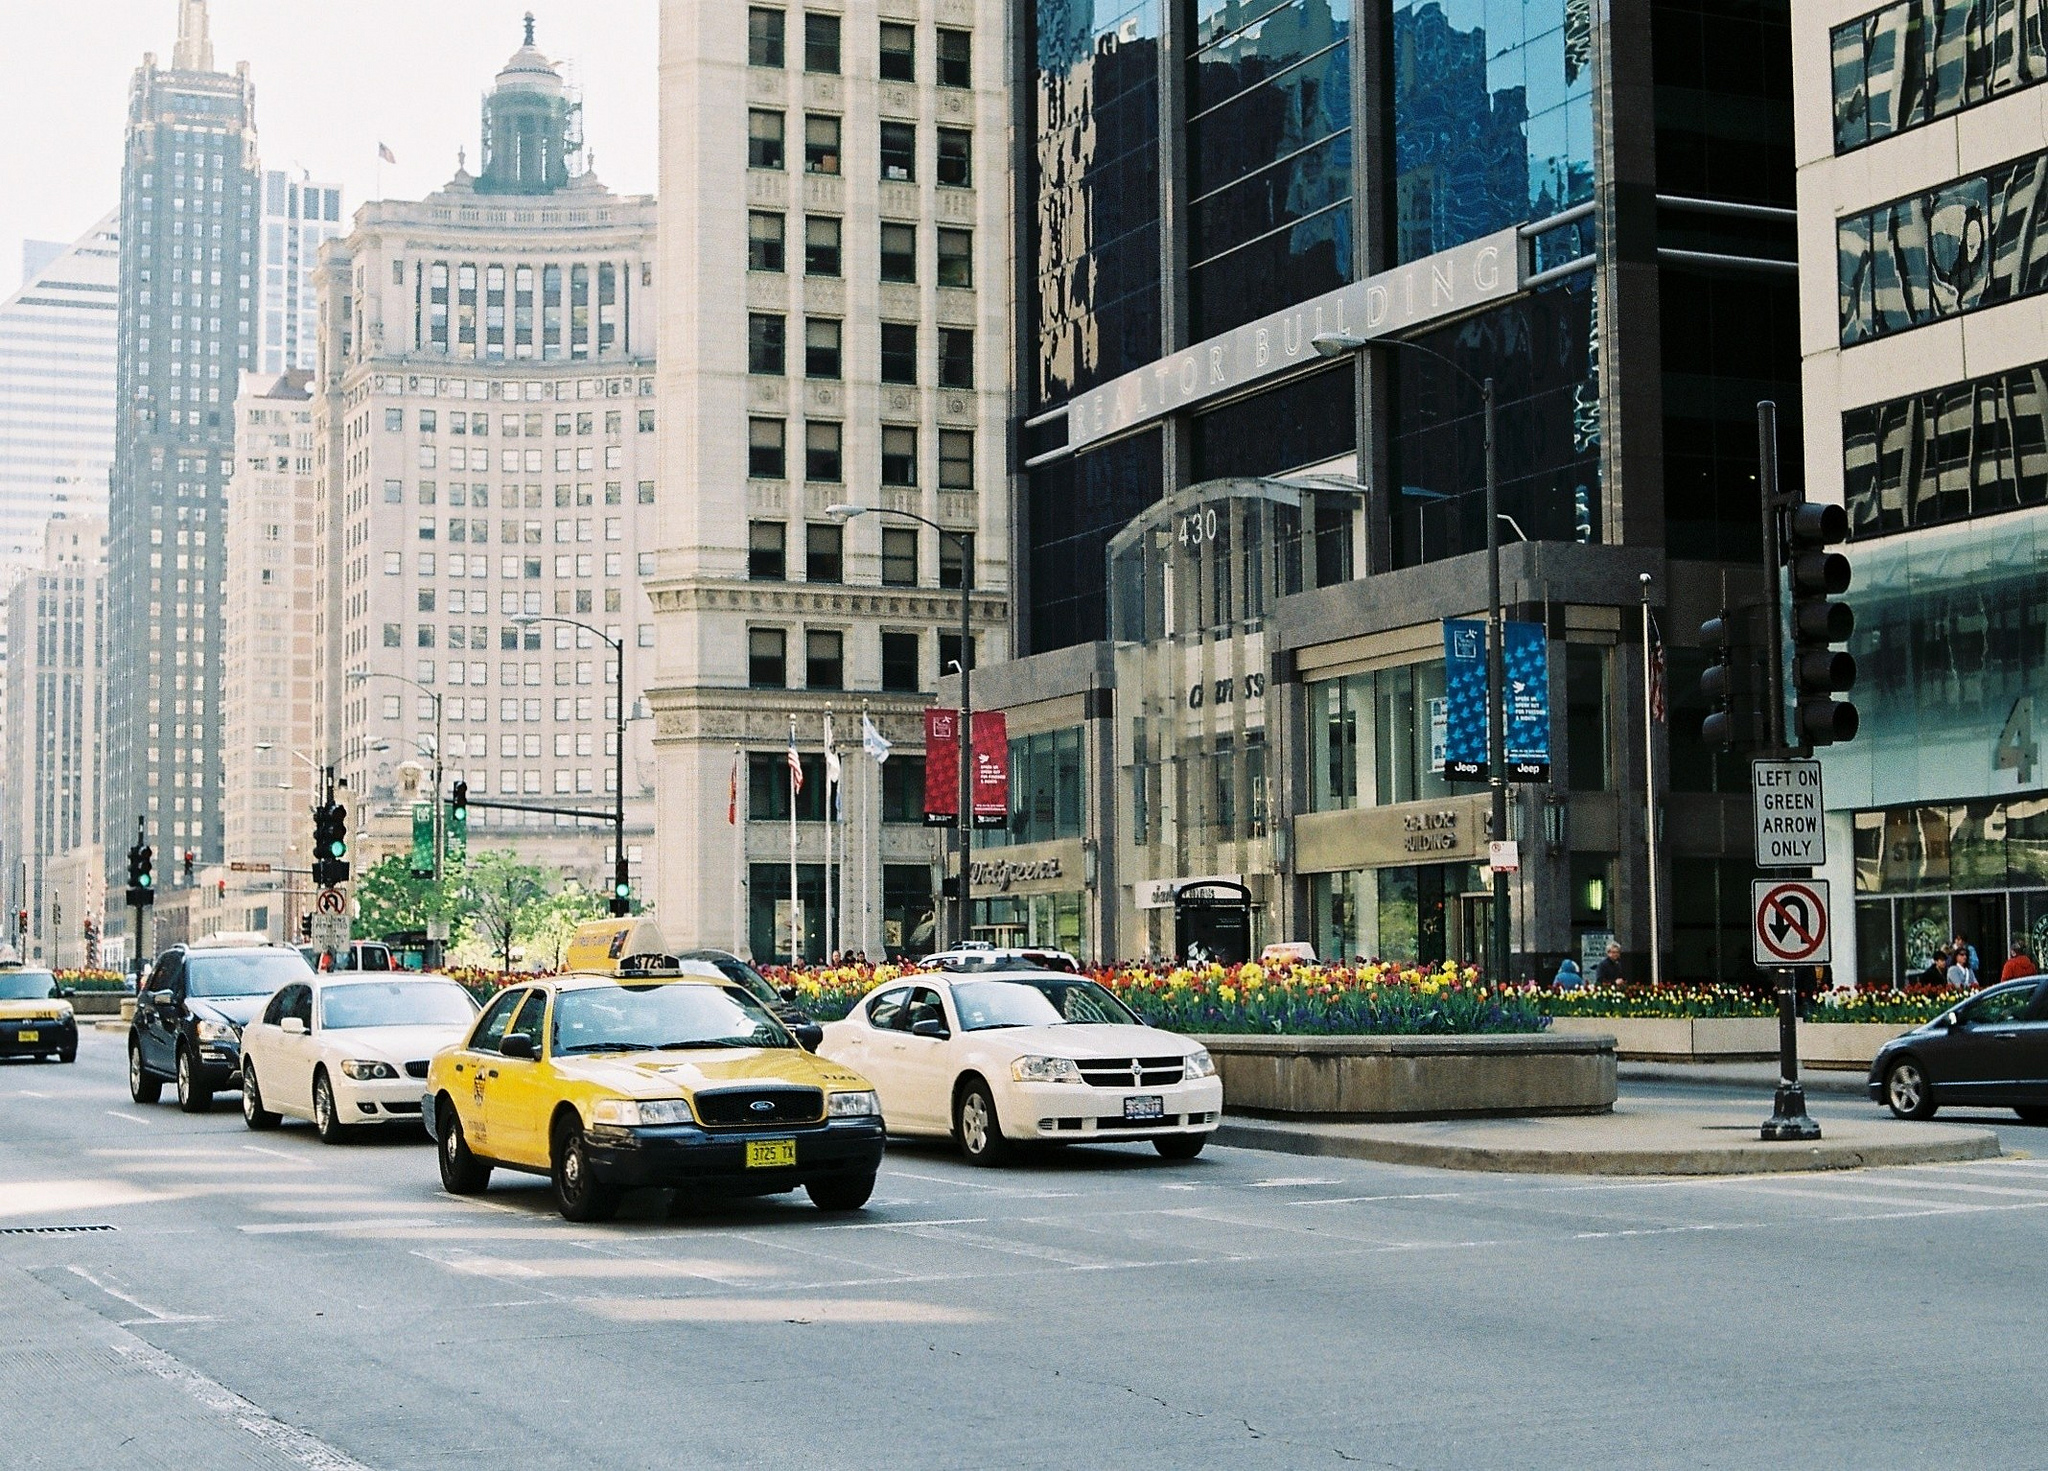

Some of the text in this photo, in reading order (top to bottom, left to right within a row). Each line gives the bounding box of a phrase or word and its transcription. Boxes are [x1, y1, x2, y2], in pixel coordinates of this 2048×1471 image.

[1255, 245, 1499, 368] BUILDING
[1178, 508, 1217, 547] 430
[1454, 762, 1478, 774] Jeep
[1517, 763, 1540, 775] Jeep
[1757, 770, 1818, 787] LEFT ON
[1764, 793, 1814, 810] GREEN
[1763, 816, 1817, 833] ARROW
[1771, 840, 1812, 857] ONLY
[635, 953, 664, 969] 3725
[753, 1145, 793, 1161] 3725 TX
